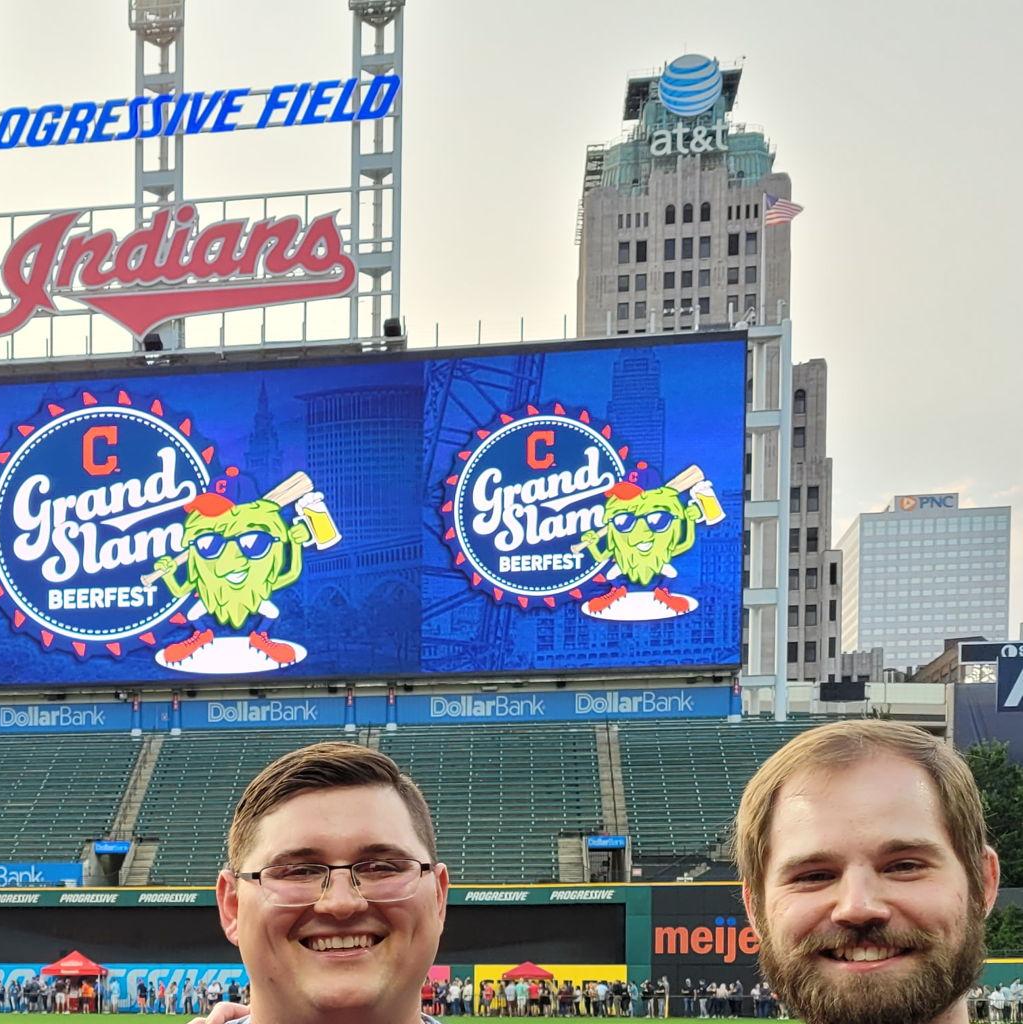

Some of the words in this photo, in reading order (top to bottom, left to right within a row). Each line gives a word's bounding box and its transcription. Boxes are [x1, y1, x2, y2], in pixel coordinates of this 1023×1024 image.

[257, 74, 401, 130] FIELD
[649, 119, 729, 156] at&t
[82, 426, 118, 475] C
[527, 430, 555, 470] C
[13, 447, 196, 561] Grand
[472, 446, 614, 535] Grand
[919, 495, 954, 509] PNC
[494, 503, 605, 552] Slam
[42, 521, 186, 583] Slam
[498, 553, 585, 573] BEERFEST
[48, 585, 157, 610] BEERFEST
[0, 705, 105, 727] DollarBank
[207, 699, 318, 723] DollarBank
[430, 694, 546, 717] DollarBank
[576, 690, 695, 715] DollarBank
[59, 893, 118, 903] PROGRESSIVE
[138, 893, 198, 903] PROGRESSIVE
[465, 890, 529, 901] PROGRESSIVE
[550, 889, 615, 900] PROGRESSIVE
[654, 916, 760, 964] meije
